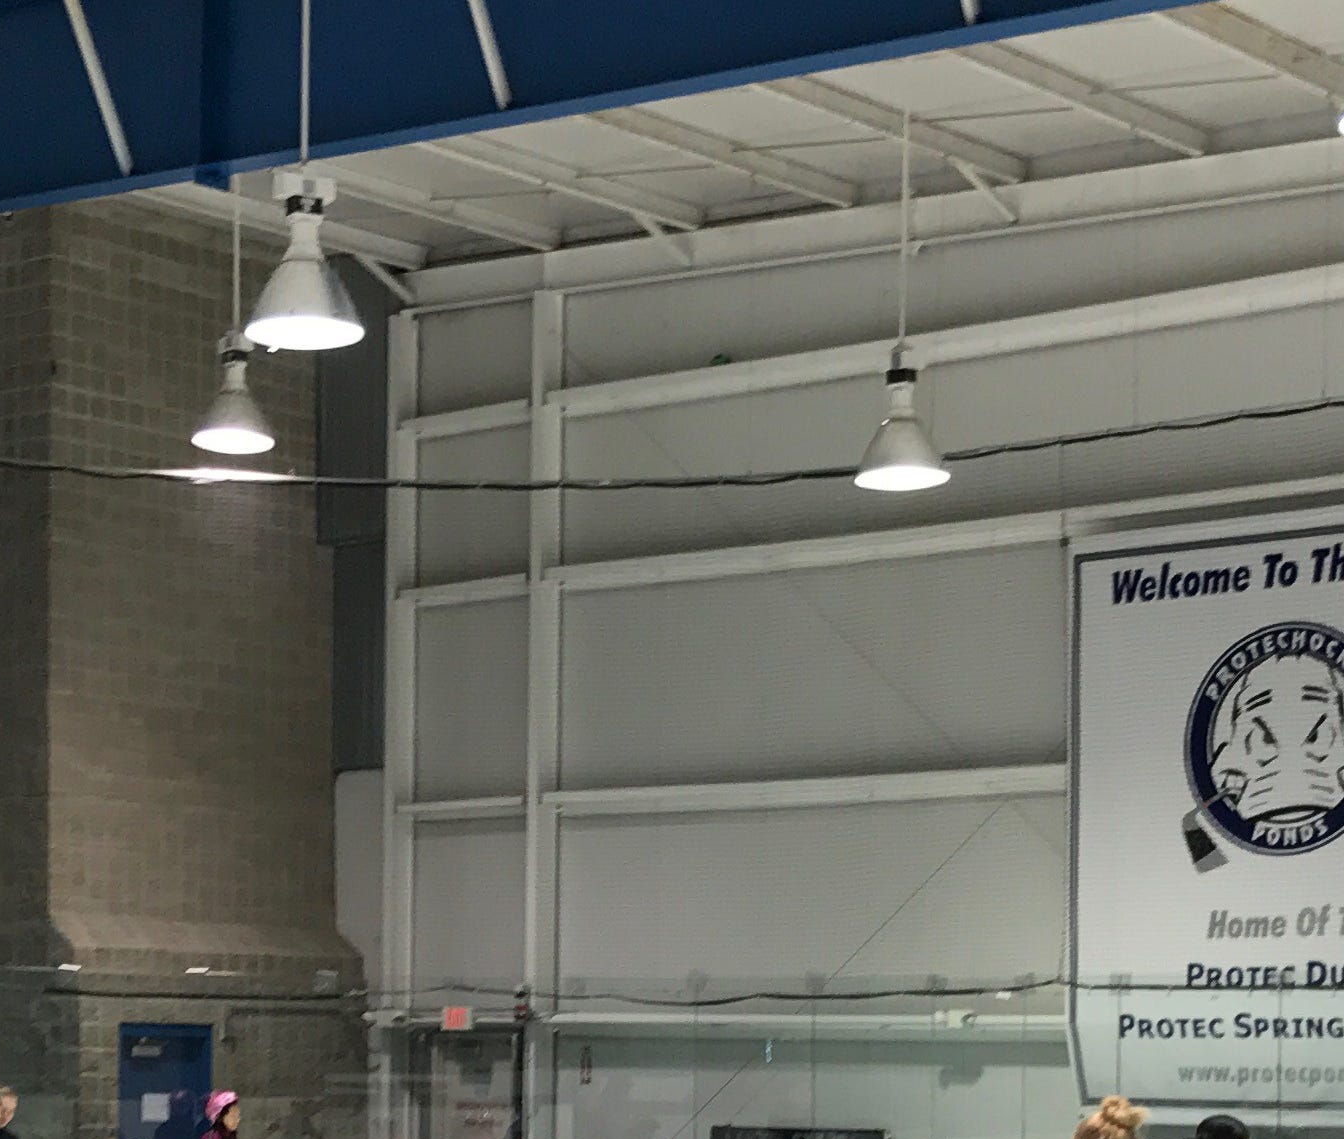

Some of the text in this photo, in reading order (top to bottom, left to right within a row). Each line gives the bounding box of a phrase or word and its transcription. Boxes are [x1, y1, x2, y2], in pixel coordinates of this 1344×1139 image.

[1112, 561, 1251, 605] Welcome
[1263, 552, 1298, 589] To
[1251, 818, 1329, 847] PONDS
[1207, 909, 1287, 939] Home
[1296, 903, 1330, 937] Of
[1186, 962, 1296, 989] PROTEC
[1119, 1013, 1225, 1039] PROTEC
[1234, 1012, 1344, 1039] SPRING
